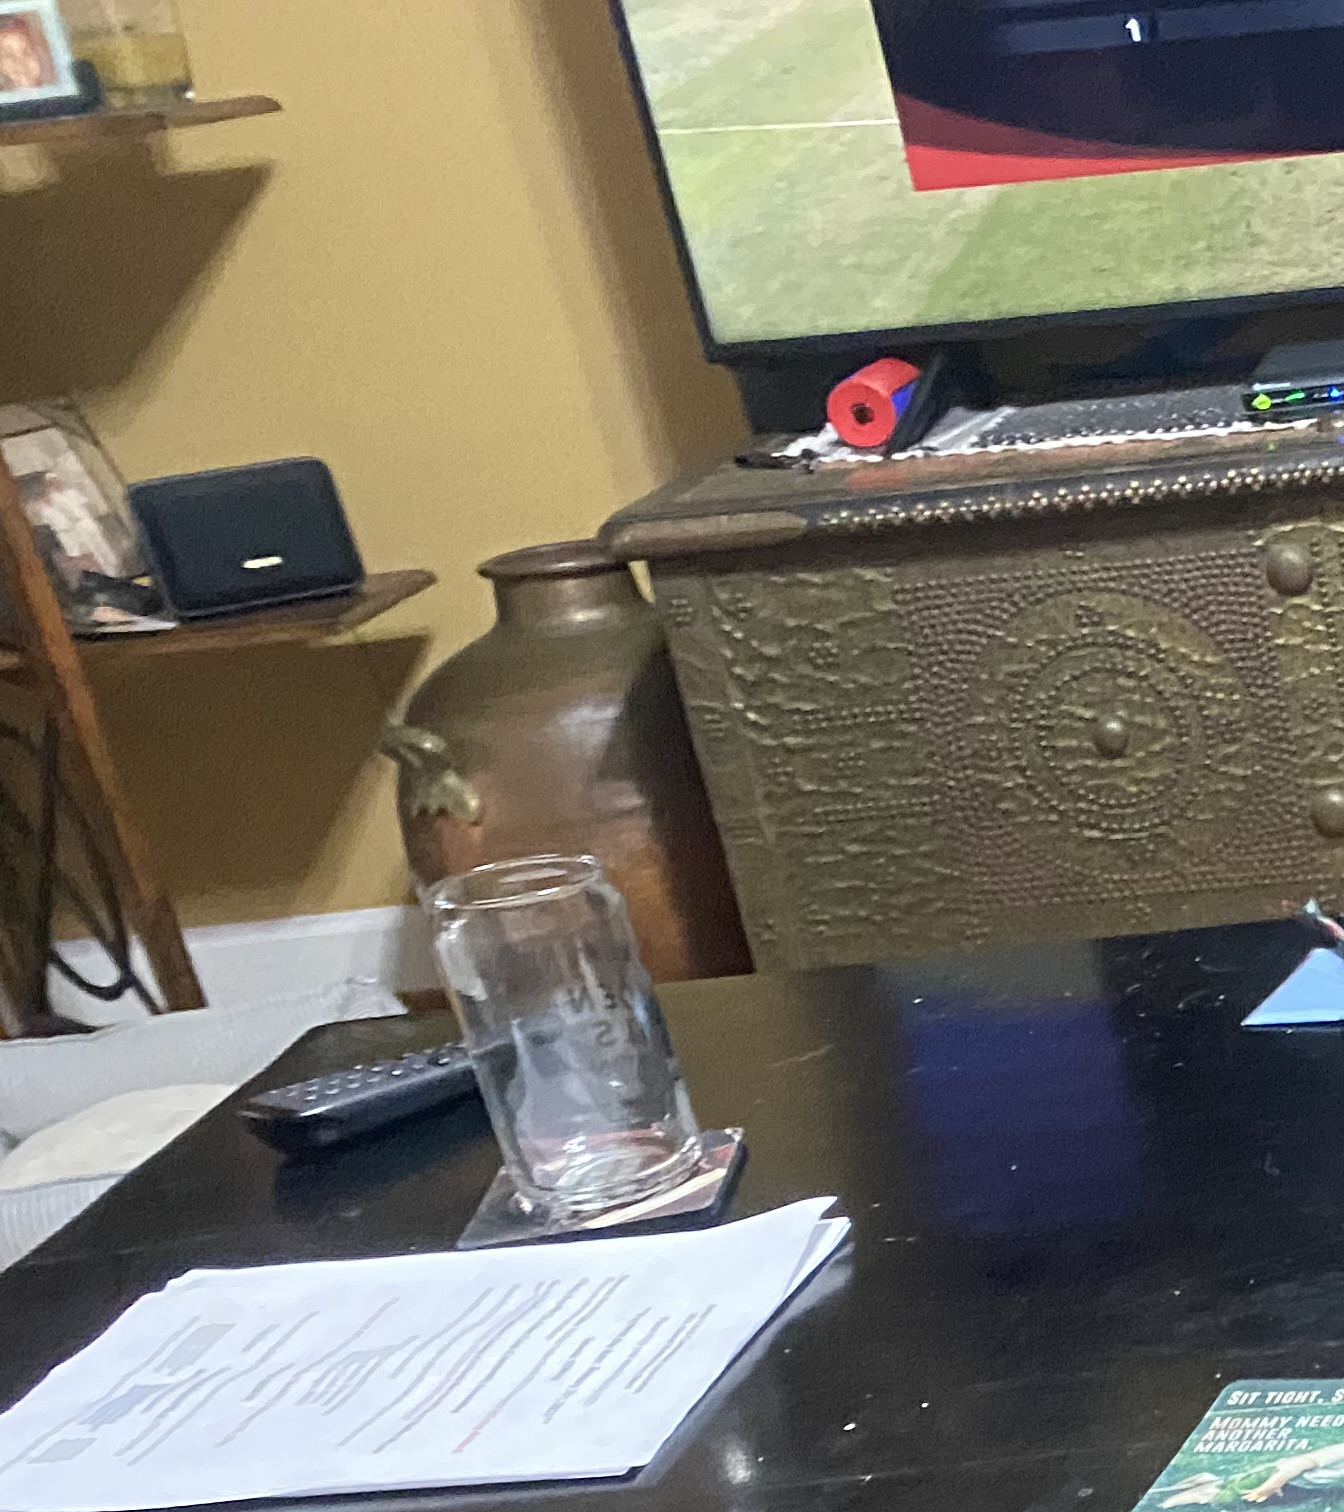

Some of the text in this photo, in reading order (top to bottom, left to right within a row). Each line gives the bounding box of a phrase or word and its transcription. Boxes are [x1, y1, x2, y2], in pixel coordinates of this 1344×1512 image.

[1125, 18, 1142, 42] 1
[1226, 1391, 1261, 1406] SIT
[1209, 1416, 1293, 1430] MOMMY
[1200, 1427, 1293, 1442] ANOTHER
